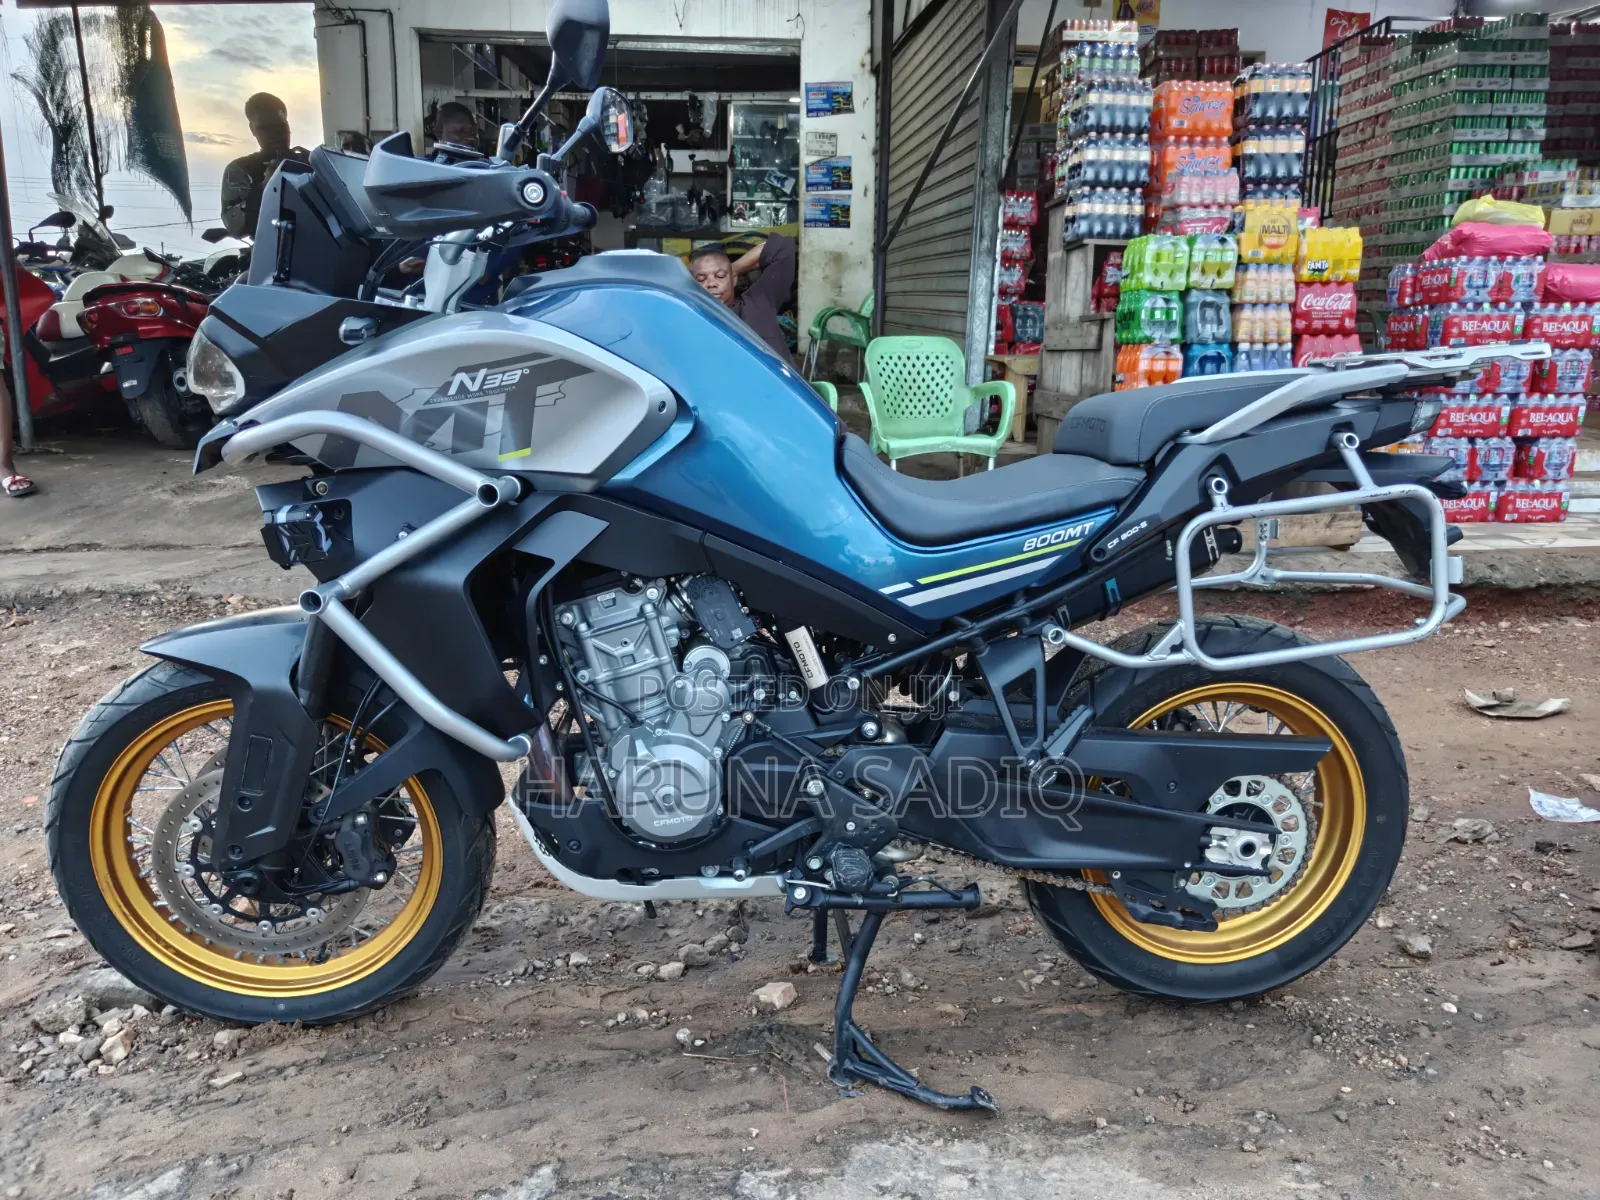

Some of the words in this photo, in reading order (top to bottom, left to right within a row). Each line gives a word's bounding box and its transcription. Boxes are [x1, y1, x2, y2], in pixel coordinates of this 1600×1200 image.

[1261, 224, 1288, 234] MALT
[1307, 259, 1329, 270] FANTA
[429, 394, 465, 404] EXPERIENCE
[467, 390, 484, 399] MORE
[485, 384, 517, 396] TOGETHER
[1023, 521, 1095, 552] 800MT
[1107, 539, 1120, 549] CF
[793, 641, 814, 679] CFMOTO
[653, 815, 693, 827] CFMOTO
